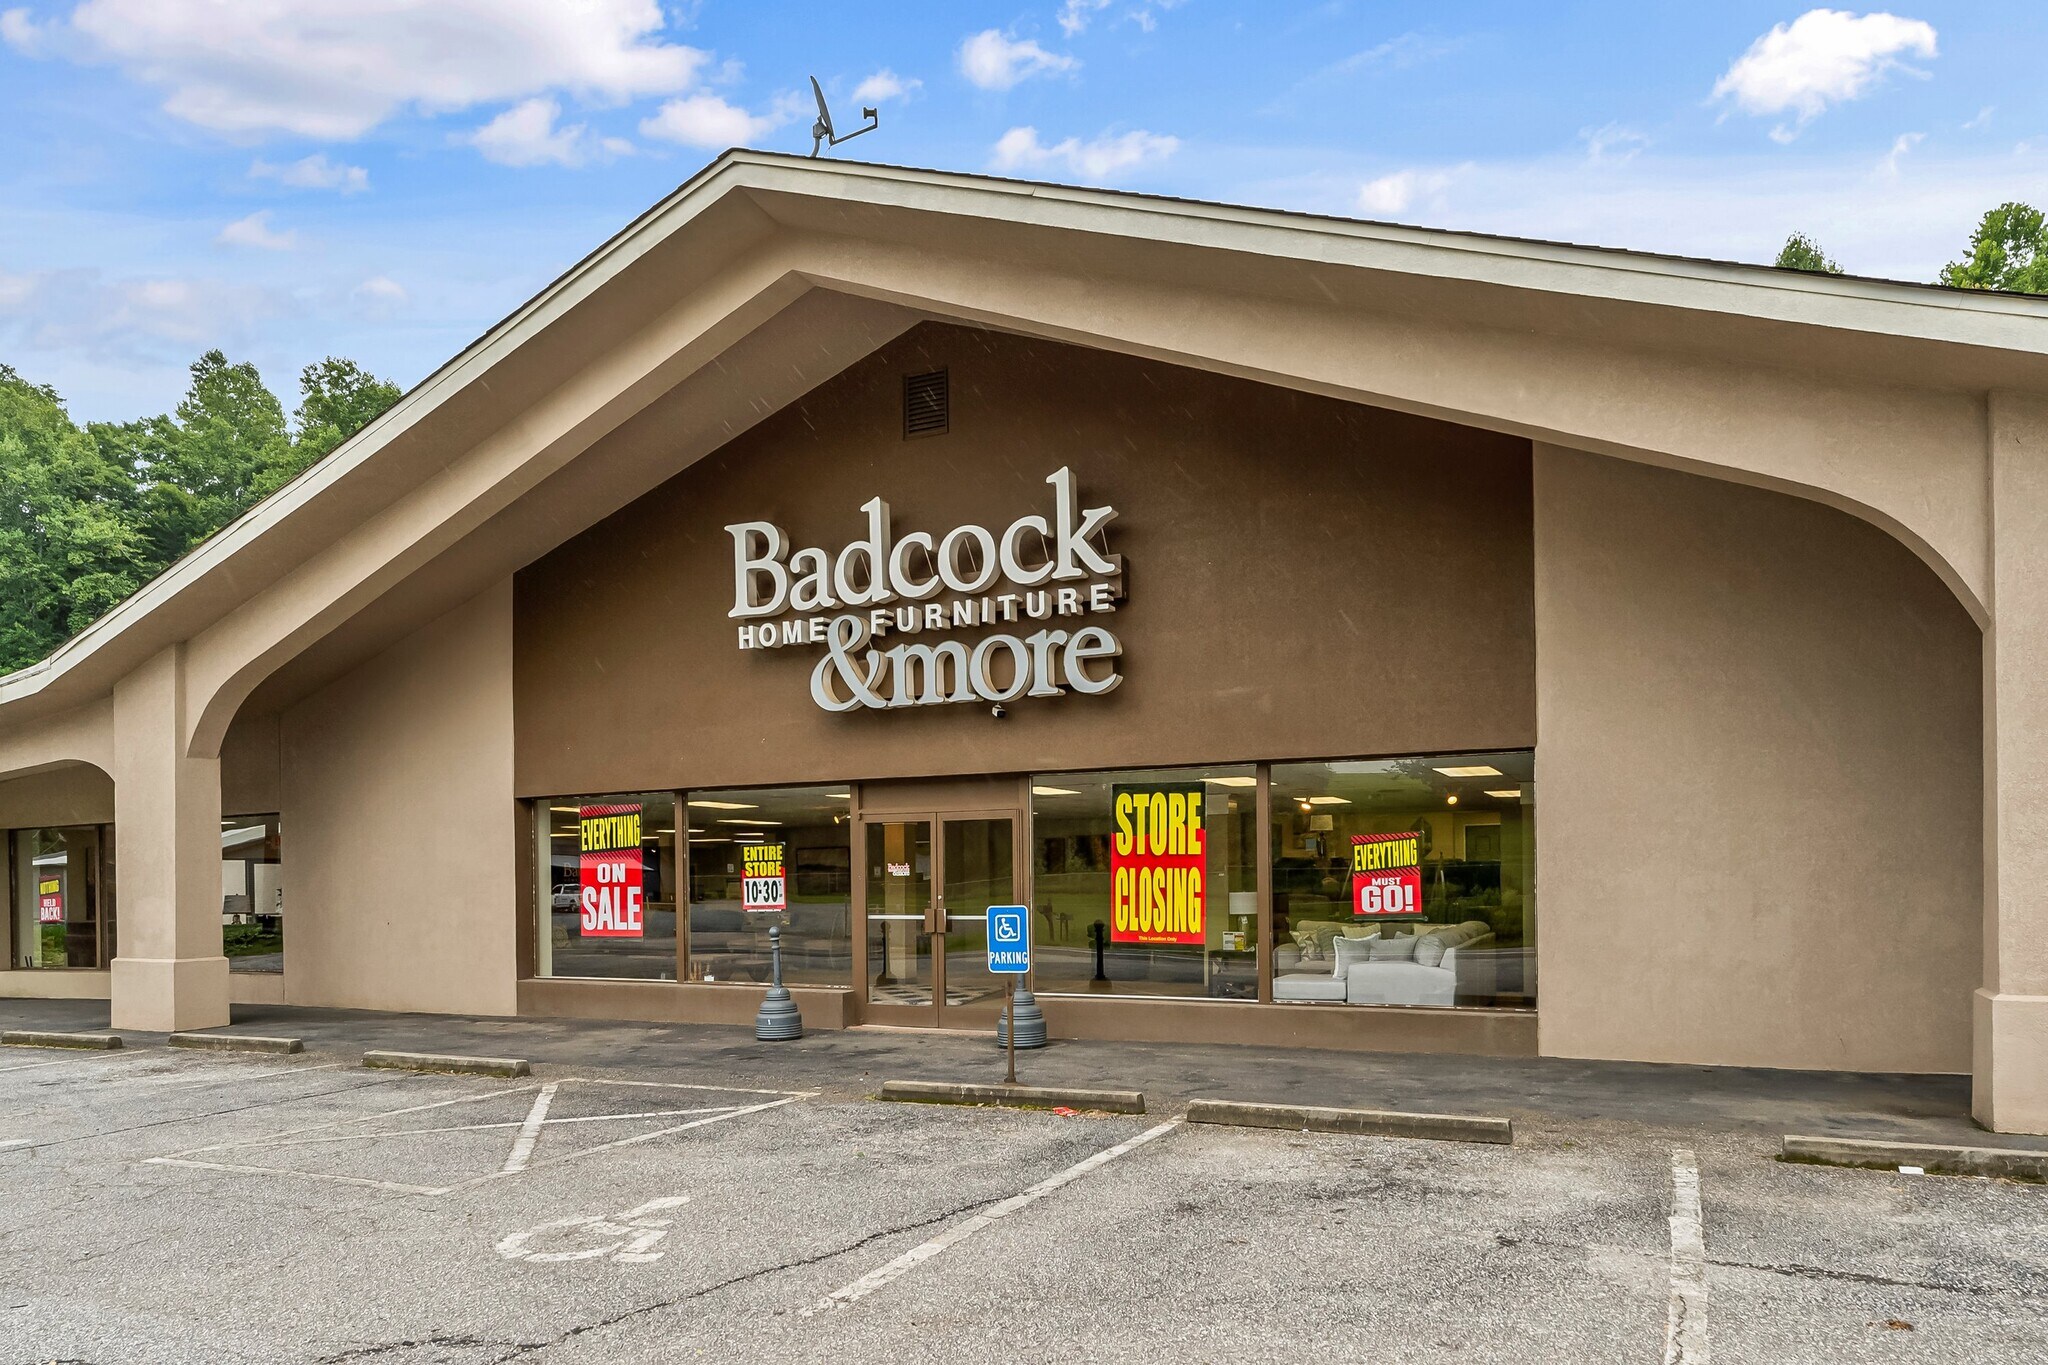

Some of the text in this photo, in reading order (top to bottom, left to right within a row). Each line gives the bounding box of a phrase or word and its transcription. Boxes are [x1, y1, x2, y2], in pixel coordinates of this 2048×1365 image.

[724, 466, 1119, 619] Badcock
[738, 583, 1115, 650] HOME FURNITURE
[809, 614, 1123, 712] &more
[581, 814, 641, 851] EVERYTHING
[1115, 792, 1202, 856] STORE
[743, 845, 783, 861] ENTIRE
[745, 861, 782, 877] STORE
[1354, 838, 1417, 872] EVERYTHING
[597, 863, 626, 884] ON
[1371, 877, 1401, 886] MUST
[41, 907, 60, 920] BACK!
[582, 886, 641, 931] SALE
[1115, 866, 1202, 934] CLOSING
[1361, 885, 1414, 913] GO!
[989, 951, 1028, 965] PARKING
